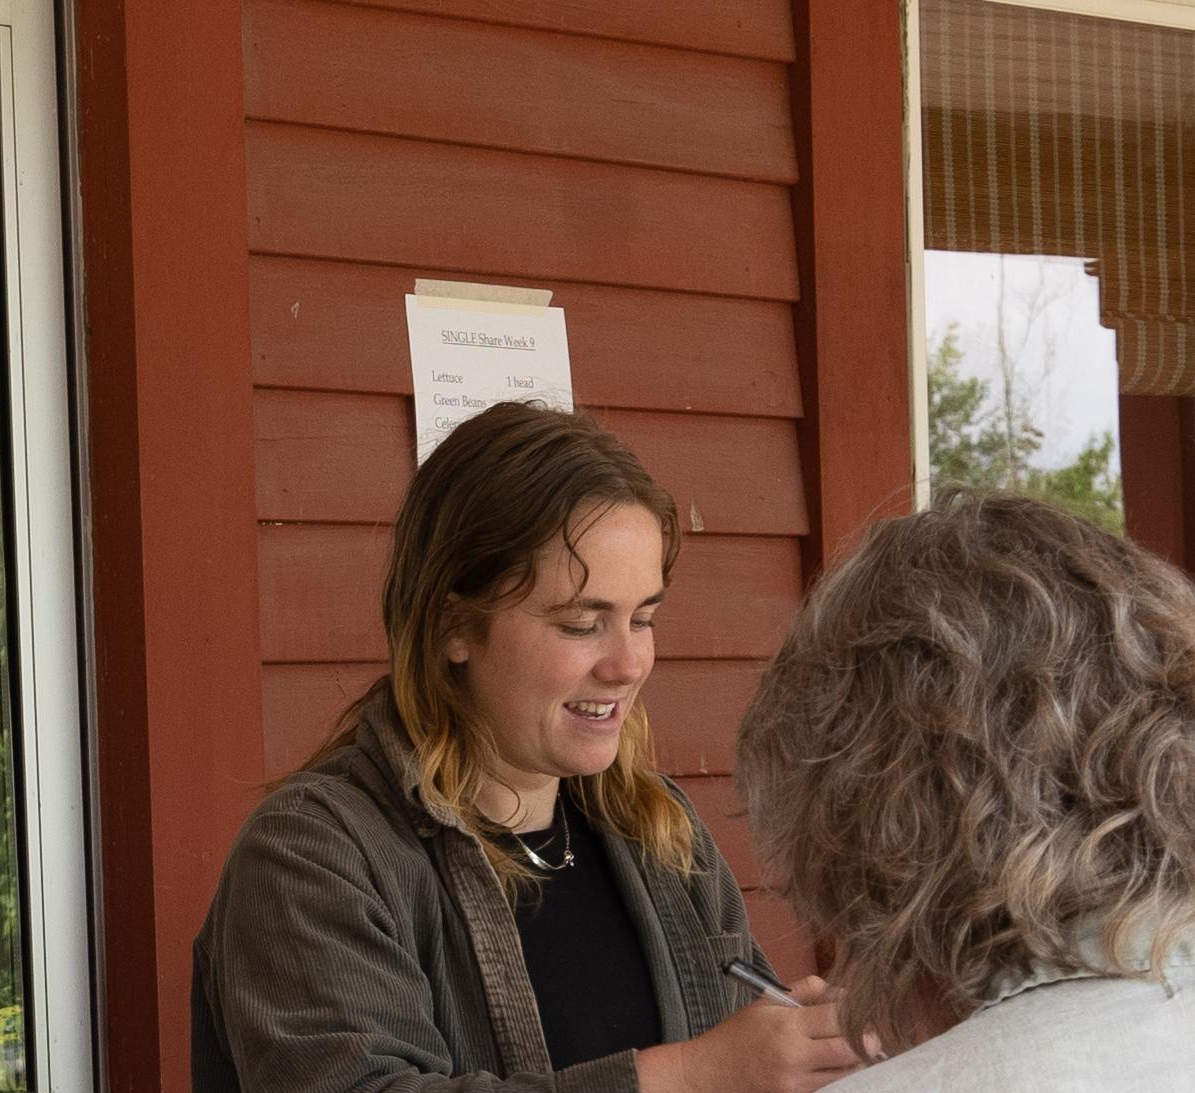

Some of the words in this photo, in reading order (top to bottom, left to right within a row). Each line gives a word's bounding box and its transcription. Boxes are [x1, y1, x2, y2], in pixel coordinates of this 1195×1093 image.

[441, 330, 477, 344] SINGLE
[478, 333, 503, 346] Share
[503, 335, 529, 348] Week
[530, 338, 535, 348] 9
[432, 370, 463, 384] Lettuce
[514, 376, 534, 389] head
[433, 393, 460, 407] Green
[462, 395, 487, 408] Beans
